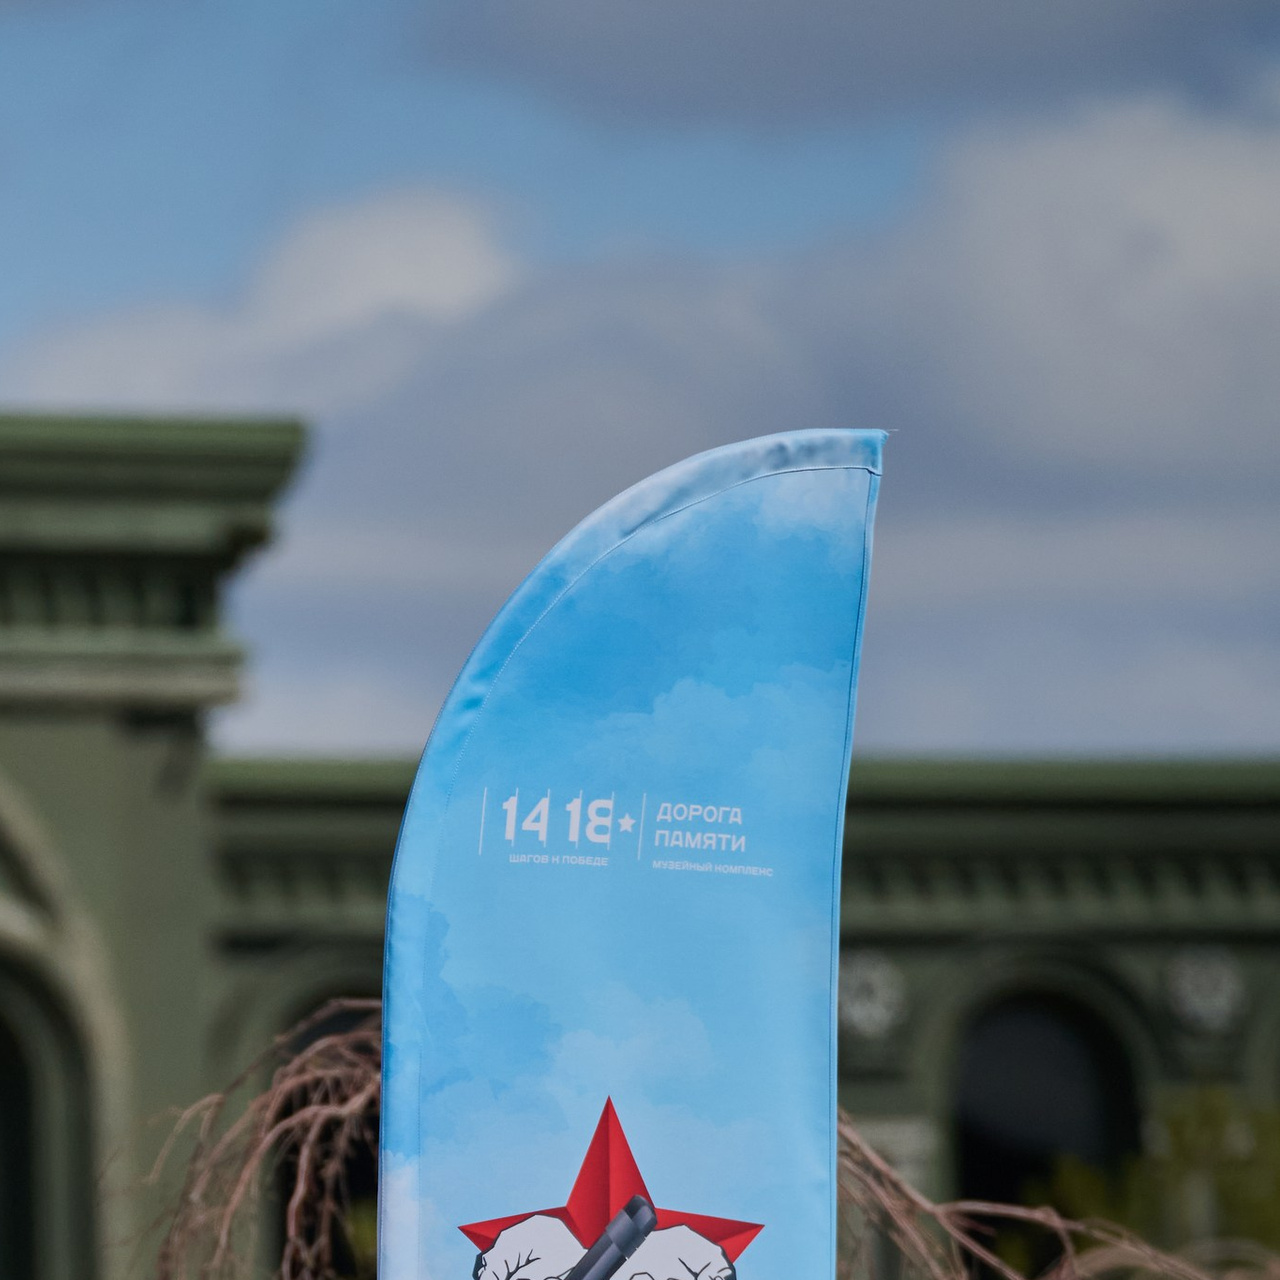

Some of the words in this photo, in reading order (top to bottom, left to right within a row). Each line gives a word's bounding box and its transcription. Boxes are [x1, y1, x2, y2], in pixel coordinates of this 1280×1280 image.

[656, 802, 743, 826] ДОРОГА
[654, 830, 747, 853] ПАМЯТИ
[509, 854, 549, 864] ШАГОВ
[563, 855, 609, 867] ПОБЕДЕ
[652, 860, 713, 872] МУЗЕЙНЫЙ
[715, 864, 774, 877] КОМПЛЕКС
